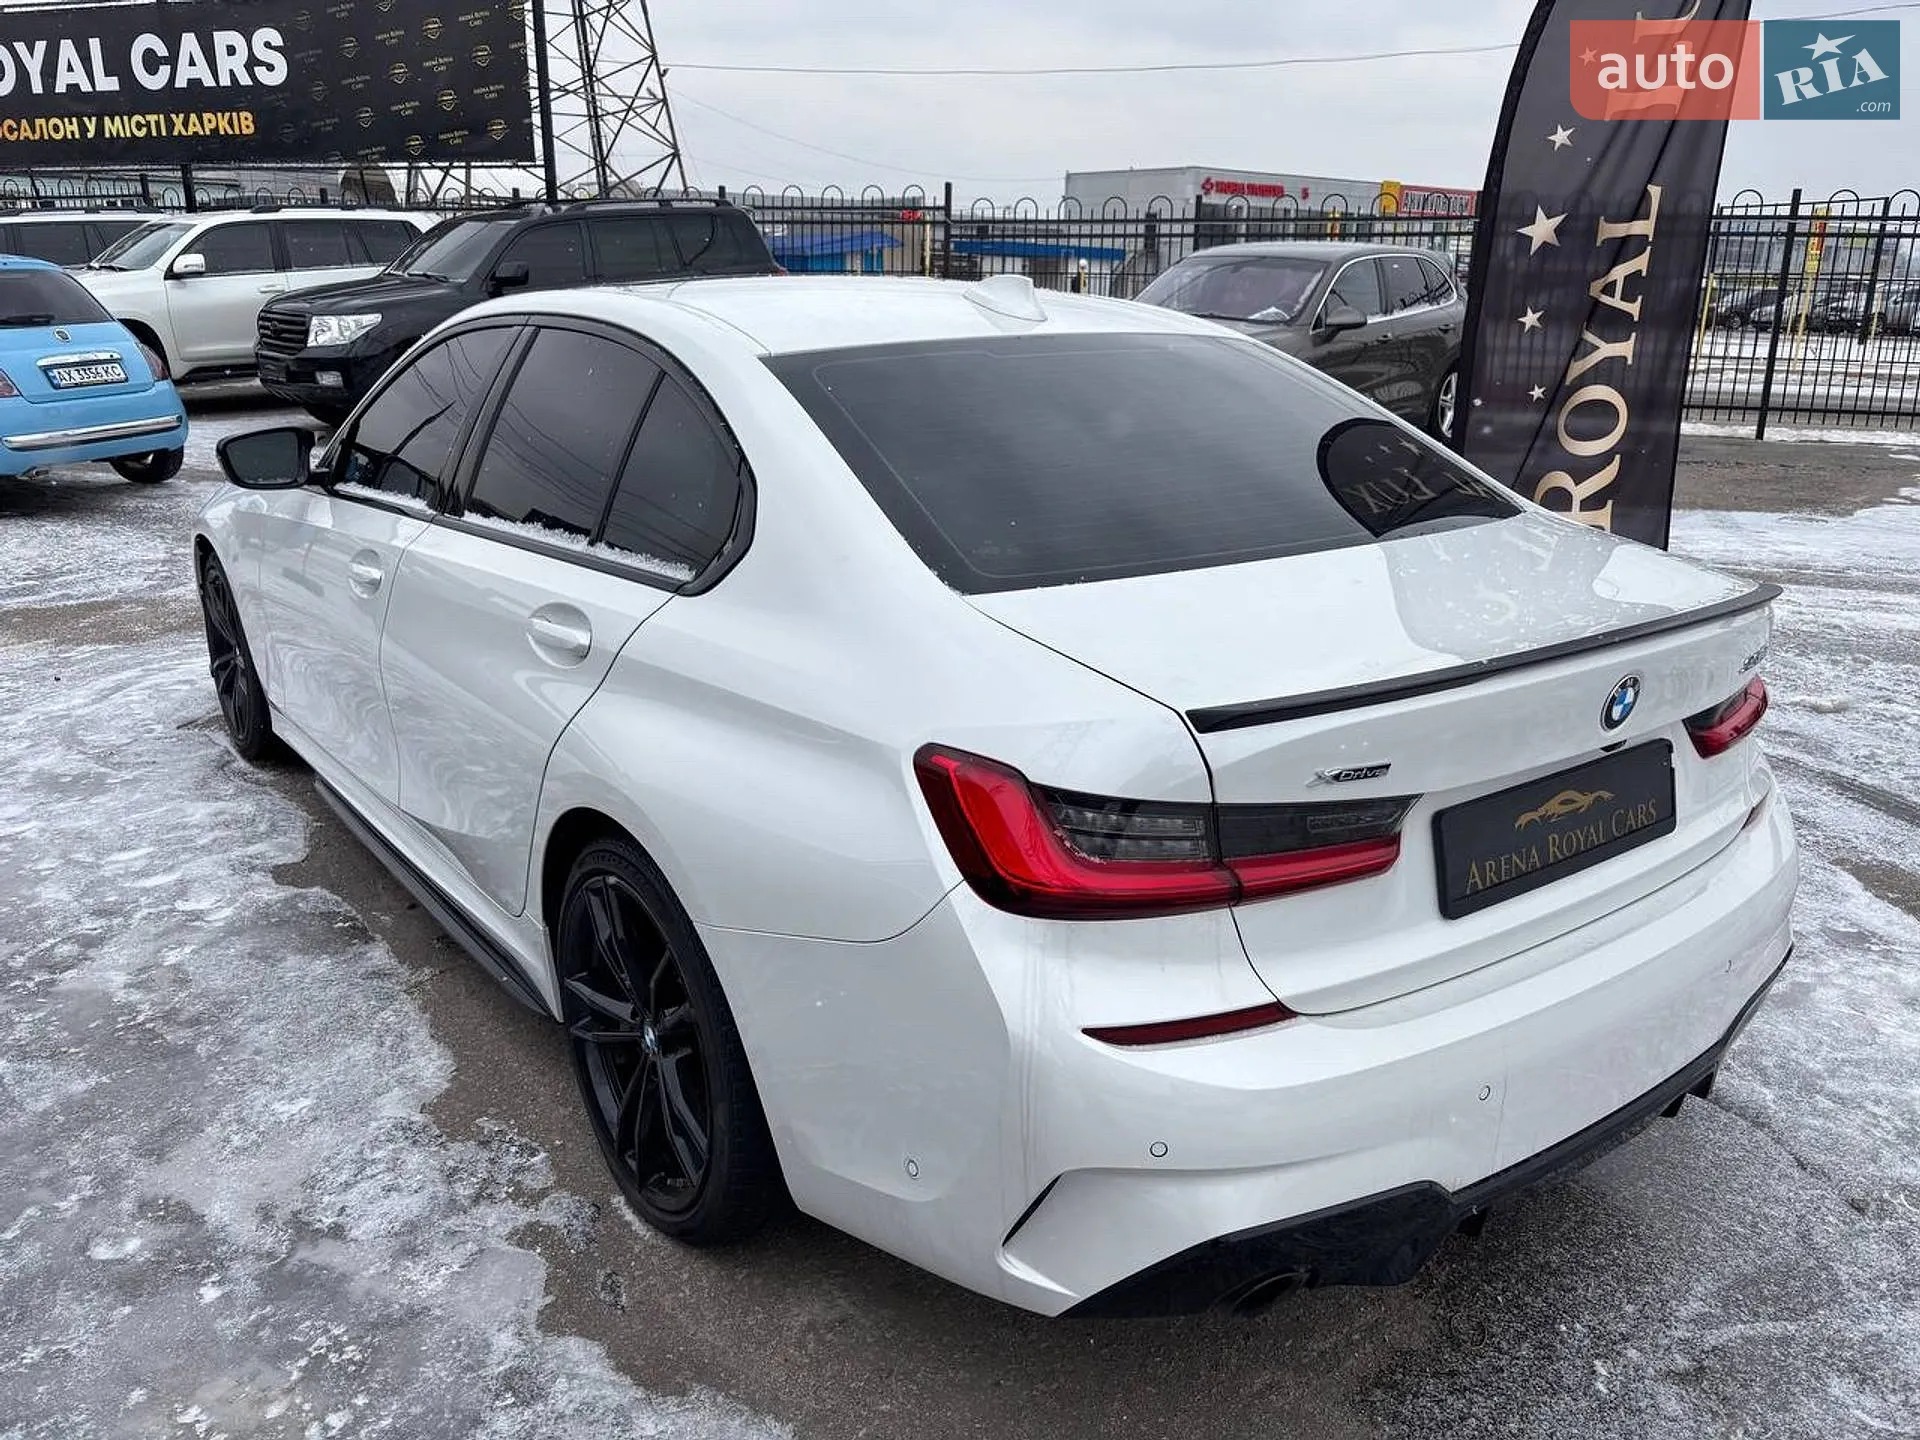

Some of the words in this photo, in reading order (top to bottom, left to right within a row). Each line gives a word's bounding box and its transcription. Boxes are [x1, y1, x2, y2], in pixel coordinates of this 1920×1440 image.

[131, 27, 288, 91] CARS
[0, 117, 80, 141] САЛОН
[83, 116, 97, 139] У
[104, 114, 167, 139] МІСТІ
[170, 110, 255, 137] ХАРКІВ
[57, 368, 77, 382] AX
[1534, 184, 1662, 532] ROYAL
